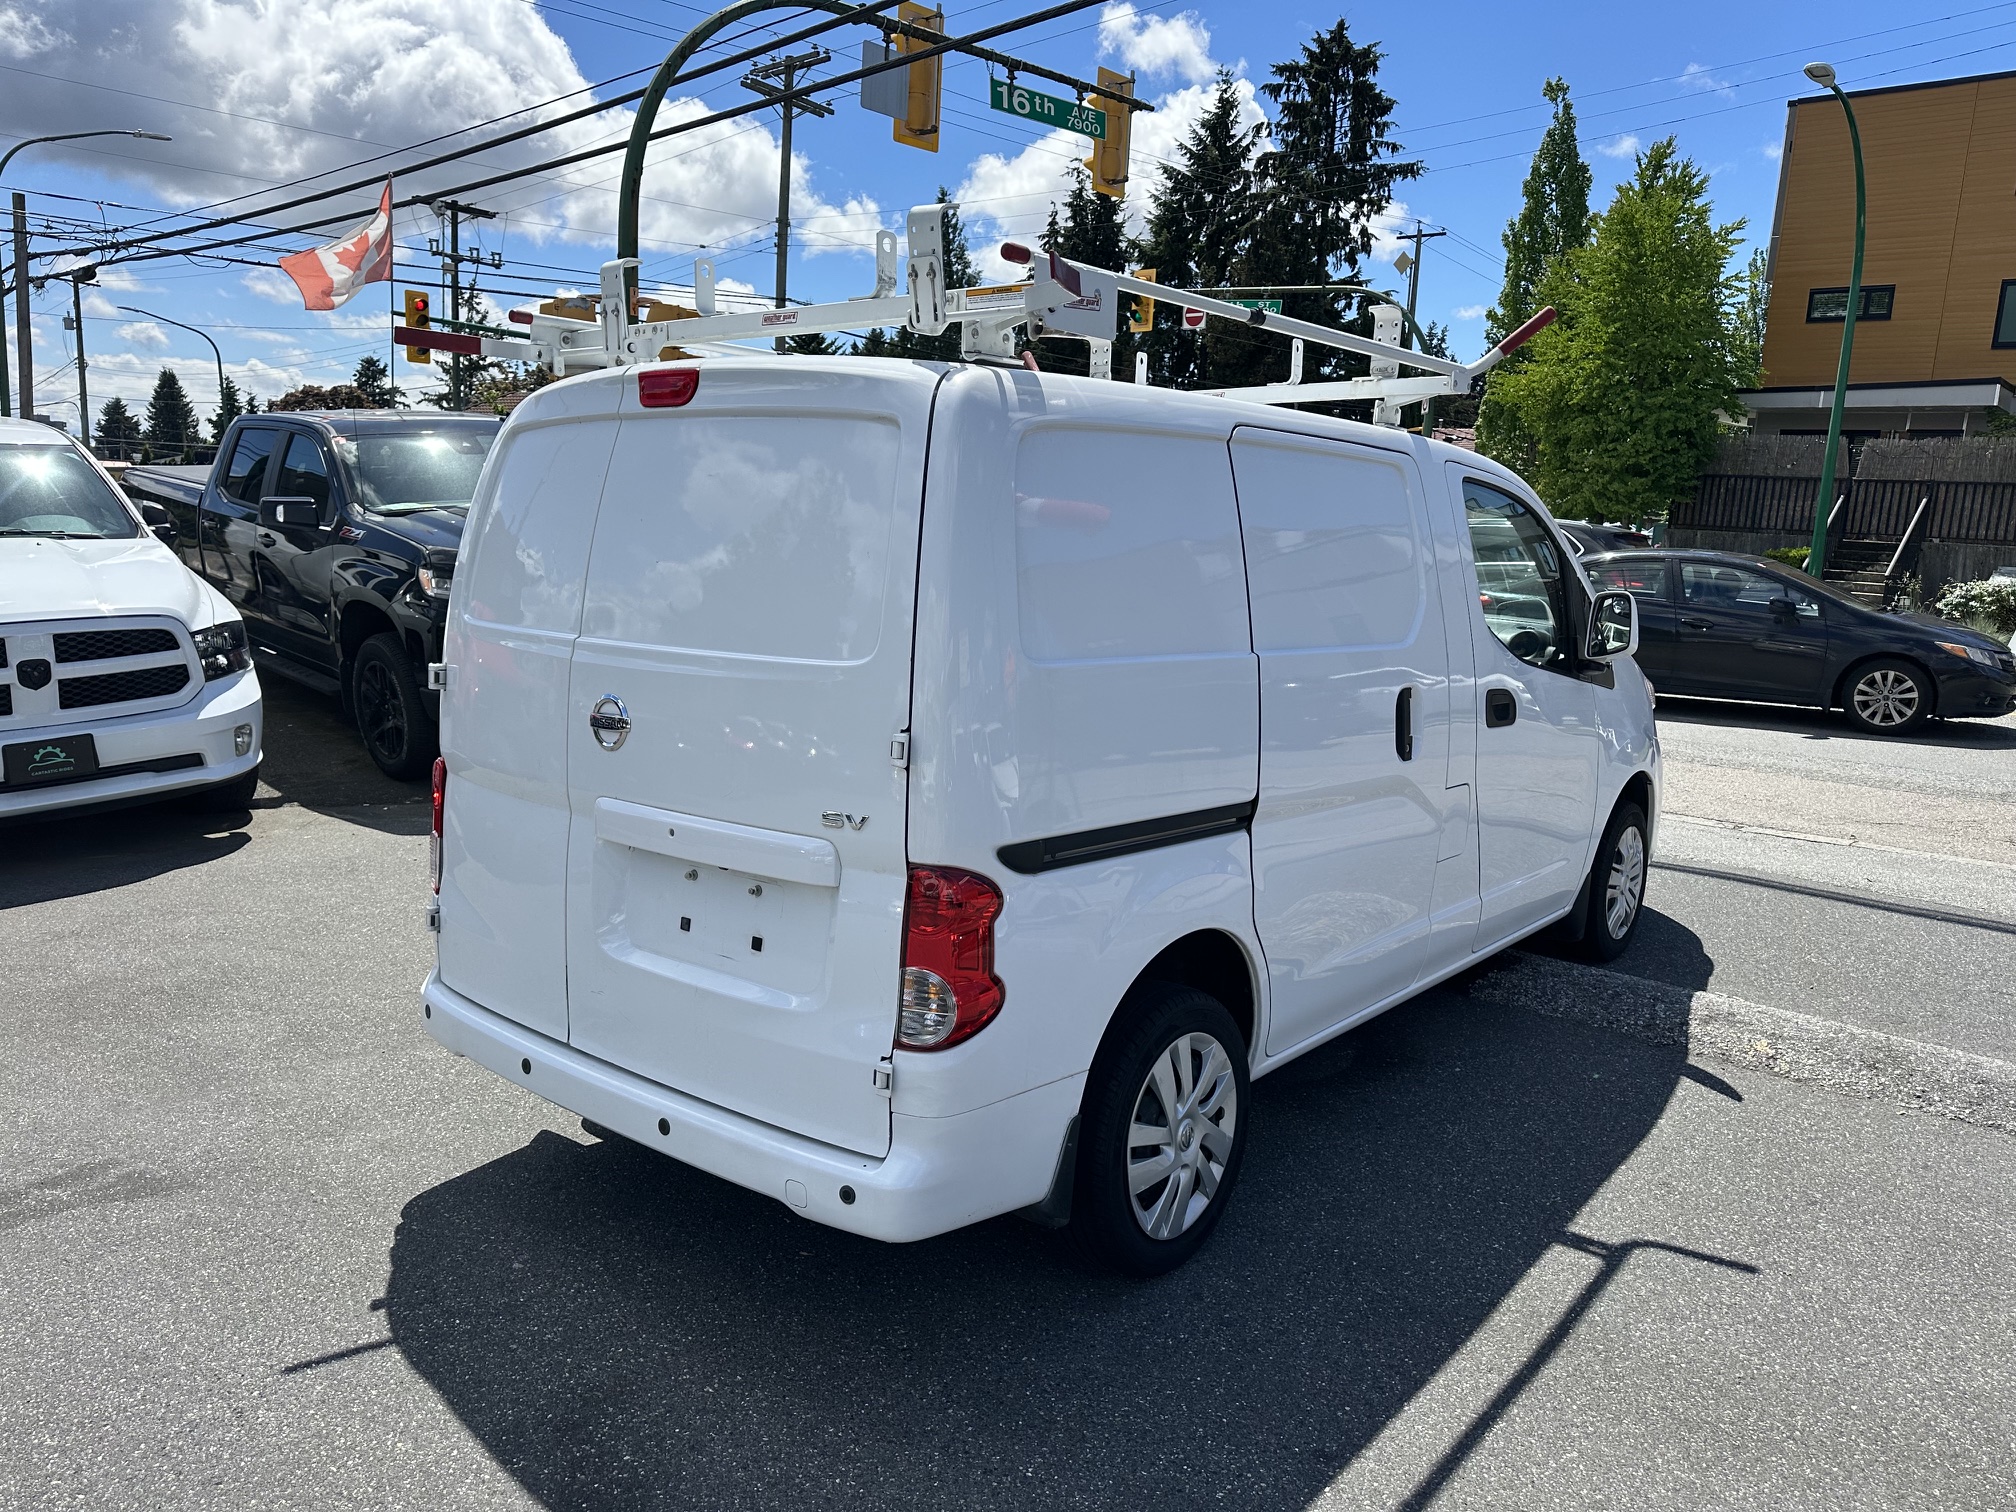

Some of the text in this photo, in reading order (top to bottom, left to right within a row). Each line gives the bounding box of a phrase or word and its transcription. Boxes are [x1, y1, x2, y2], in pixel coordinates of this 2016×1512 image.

[997, 85, 1055, 116] 16th
[1071, 106, 1097, 123] AVE
[1066, 116, 1101, 135] 7900
[821, 809, 870, 831] SV
